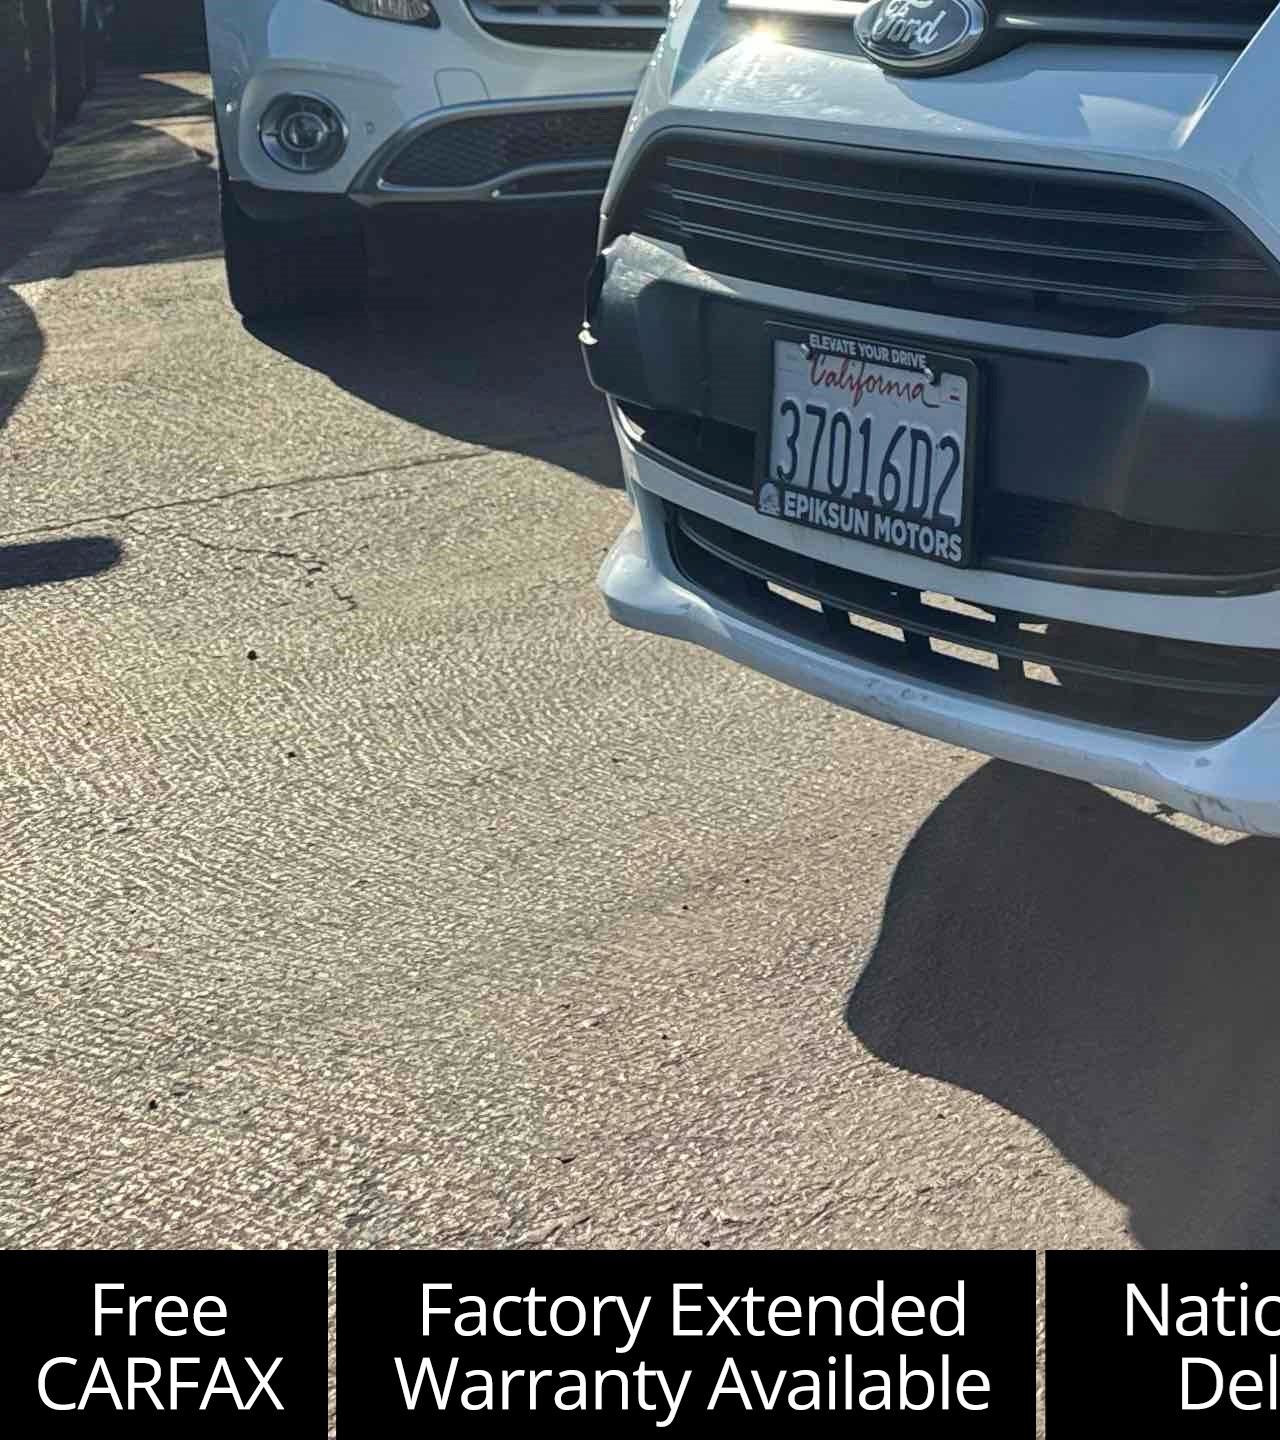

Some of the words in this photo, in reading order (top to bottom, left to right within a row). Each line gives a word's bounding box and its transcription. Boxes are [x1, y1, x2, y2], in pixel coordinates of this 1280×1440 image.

[809, 333, 857, 356] ELEVATE
[858, 343, 890, 362] YOUR
[891, 351, 927, 368] DRIVE
[809, 355, 940, 409] California
[776, 399, 961, 526] 37016D2
[783, 490, 869, 538] EPIKSUN
[873, 515, 962, 562] MOTORS
